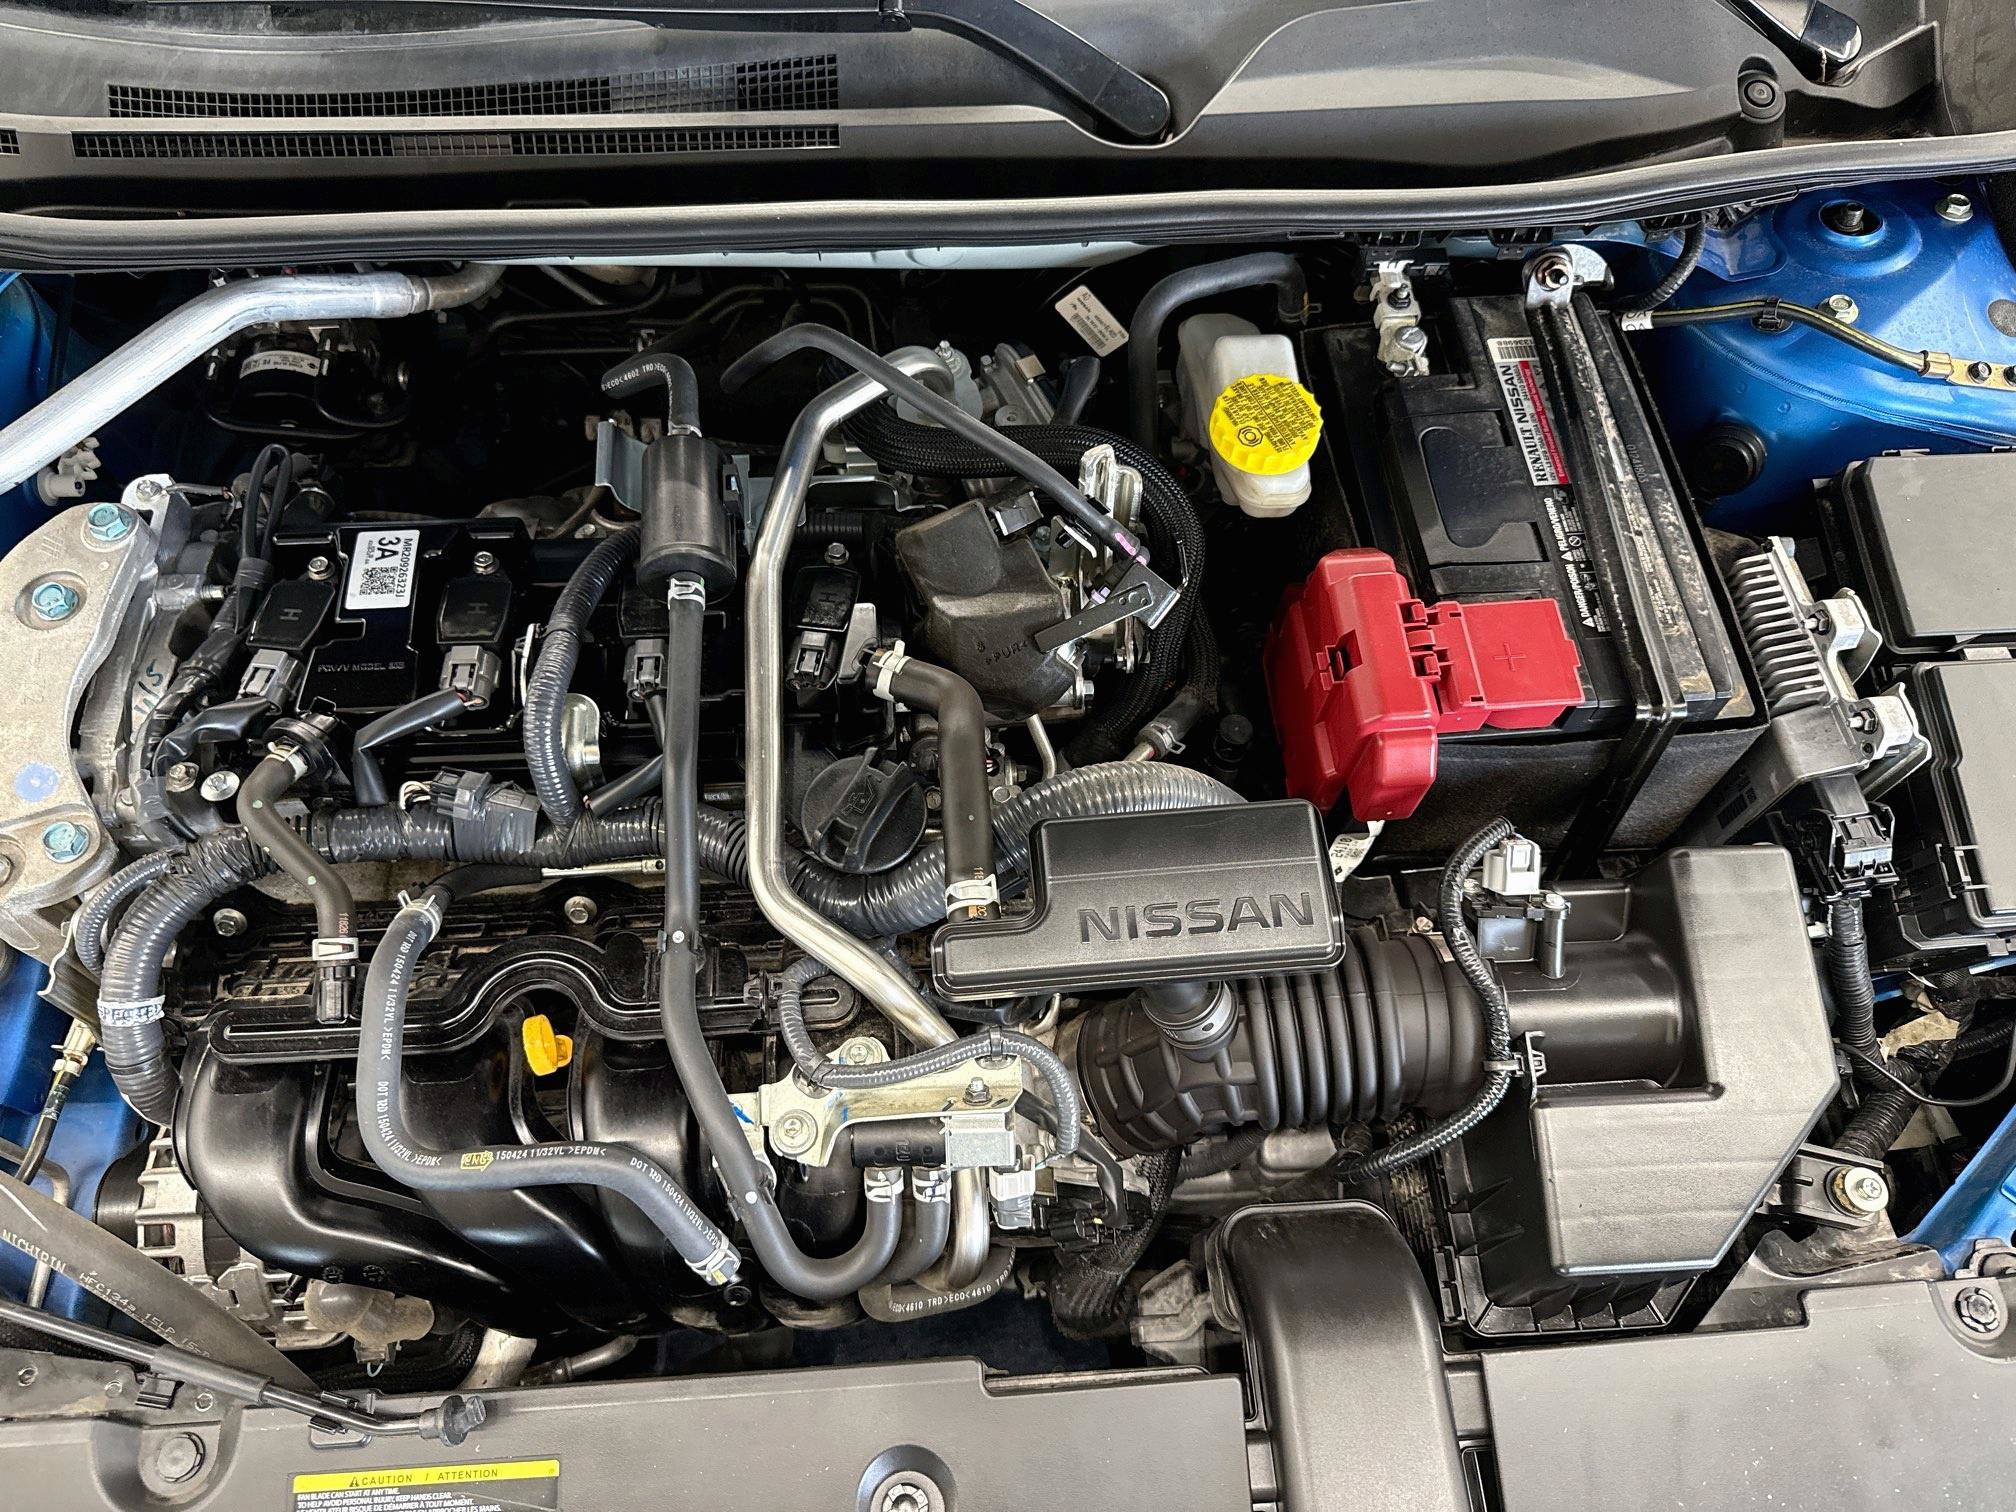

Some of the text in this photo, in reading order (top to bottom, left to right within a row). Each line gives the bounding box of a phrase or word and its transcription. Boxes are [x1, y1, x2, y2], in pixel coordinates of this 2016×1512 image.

[1500, 365, 1529, 424] NISSAN
[1520, 427, 1548, 483] RENAULT
[375, 537, 402, 561] 3A
[395, 538, 414, 598] MR20926323J
[1078, 891, 1315, 944] NISSAN
[377, 1081, 390, 1096] DOT
[495, 1145, 607, 1161] 150424 11/32VL >EPDM<
[630, 1157, 648, 1173] DOT
[662, 1180, 685, 1206] 150424
[3, 1229, 67, 1273] NICHIRIN
[361, 1474, 413, 1486] CAUTION
[438, 1468, 499, 1481] ATTENTION
[307, 1500, 322, 1508] HELP
[323, 1499, 342, 1507] AVOID
[343, 1497, 373, 1506] PERSONAL
[396, 1494, 410, 1502] KEEP
[411, 1493, 432, 1501] HANDS
[310, 1492, 331, 1501] BLADE
